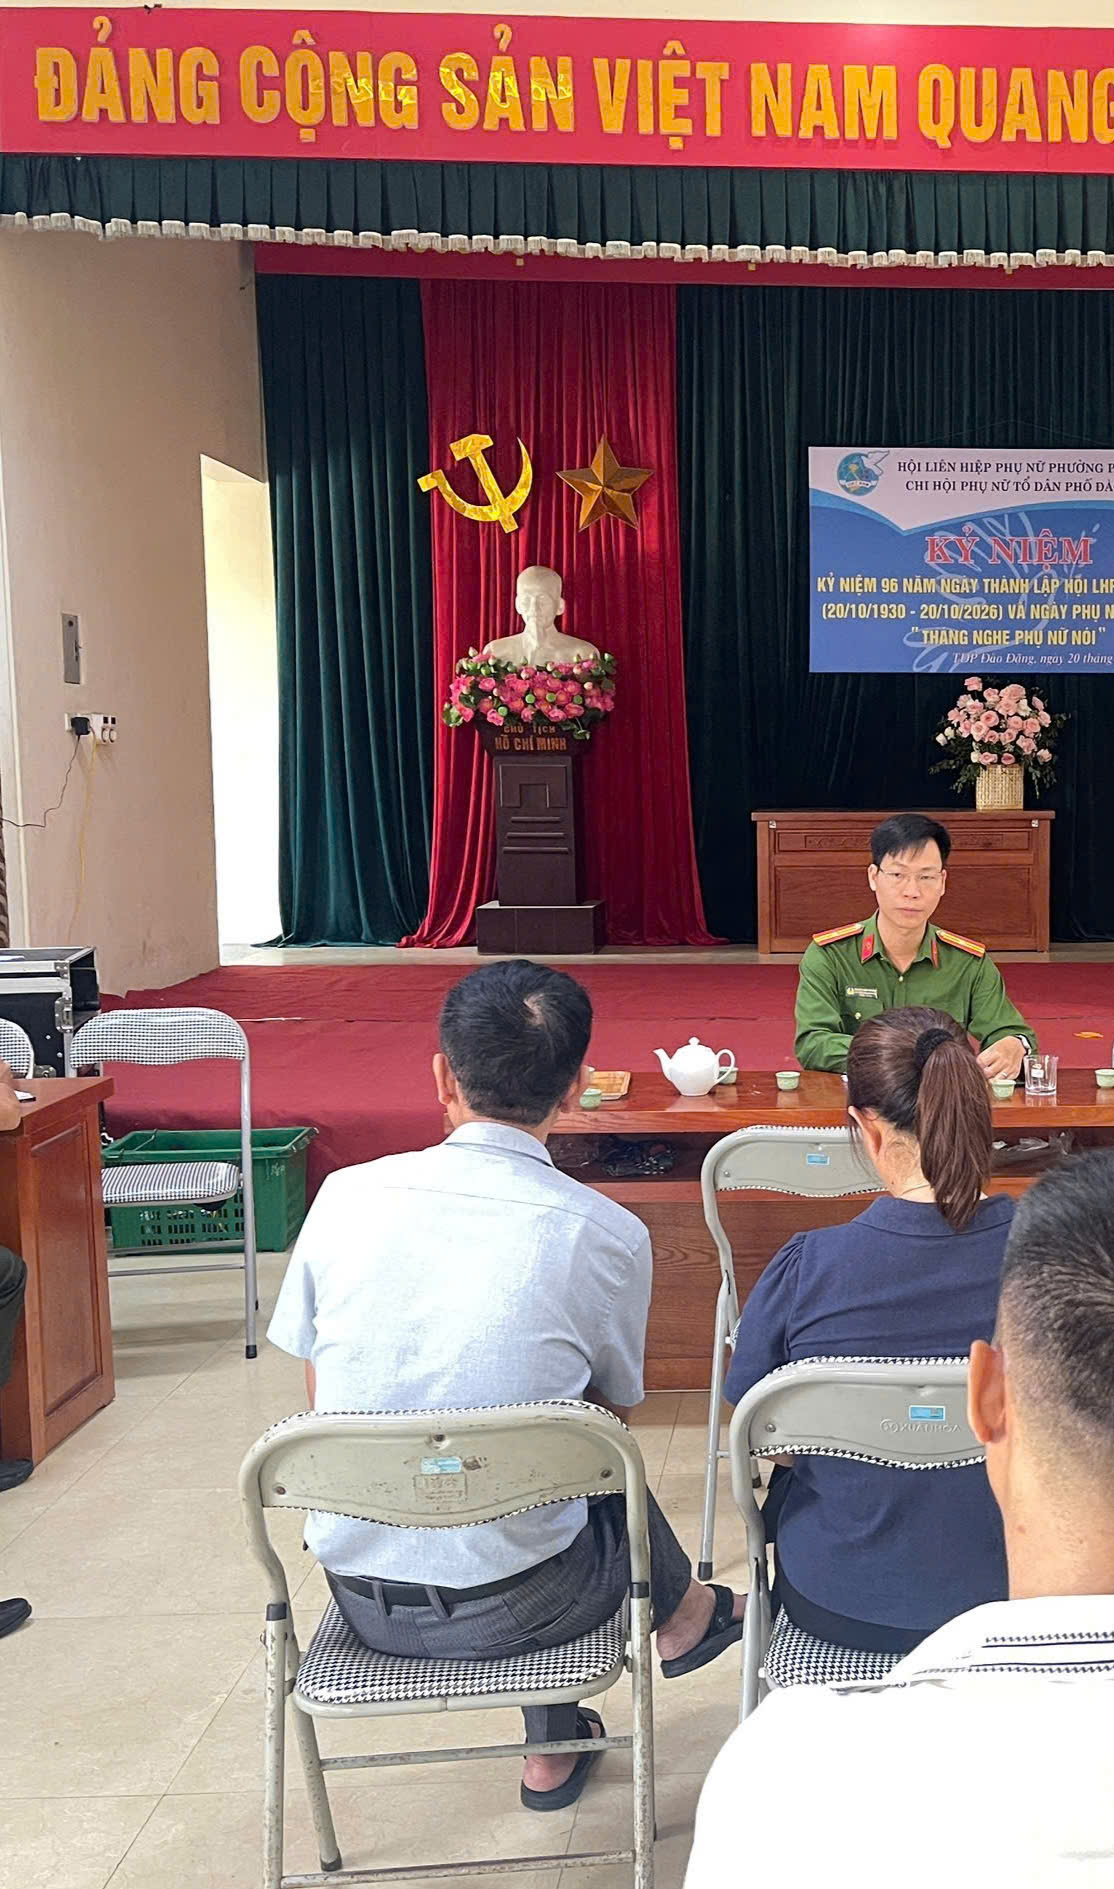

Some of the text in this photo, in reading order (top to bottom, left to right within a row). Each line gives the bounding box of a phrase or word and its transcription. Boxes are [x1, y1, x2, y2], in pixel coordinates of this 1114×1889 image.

[35, 17, 220, 125] ĐẢNG
[240, 29, 419, 142] CỘNG
[441, 23, 576, 132] SẢN
[593, 40, 730, 149] VIỆT
[751, 63, 898, 141] NAM
[897, 459, 921, 475] HỘI
[925, 459, 956, 472] LIÊN
[960, 460, 992, 475] HIỆP
[995, 462, 1023, 475] PHỤ
[1026, 460, 1046, 473] NỮ
[1048, 459, 1104, 473] PHƯỜNG
[905, 480, 929, 491] CHI
[933, 478, 956, 494] HỘI
[960, 481, 988, 494] PHỤ
[991, 479, 1011, 492] NỮ
[1013, 475, 1031, 492] TỔ
[1034, 478, 1061, 492] DÂN
[1065, 478, 1092, 492] PHỐ
[925, 524, 1093, 571] KỶ NIỆM
[817, 572, 835, 593] KỶ
[839, 574, 877, 596] NIỆM
[881, 577, 899, 593] 96
[903, 575, 936, 593] NĂM
[941, 575, 979, 593] NGÀY
[983, 575, 1029, 594] THÀNH
[1033, 575, 1060, 597] LẬP
[1064, 576, 1088, 597] HỘI
[822, 603, 906, 621] (20/10/1930
[919, 604, 1003, 621] 20/10/2026)
[1007, 602, 1026, 620] VÀ
[1030, 601, 1068, 620] NGÀY
[1071, 604, 1101, 622] PHỤ
[973, 630, 1011, 645] NGHE
[1015, 630, 1043, 649] PHỤ
[1047, 627, 1069, 645] NỮ
[1068, 653, 1081, 664] 20
[495, 734, 567, 751] HỒ CHÍ MINH
